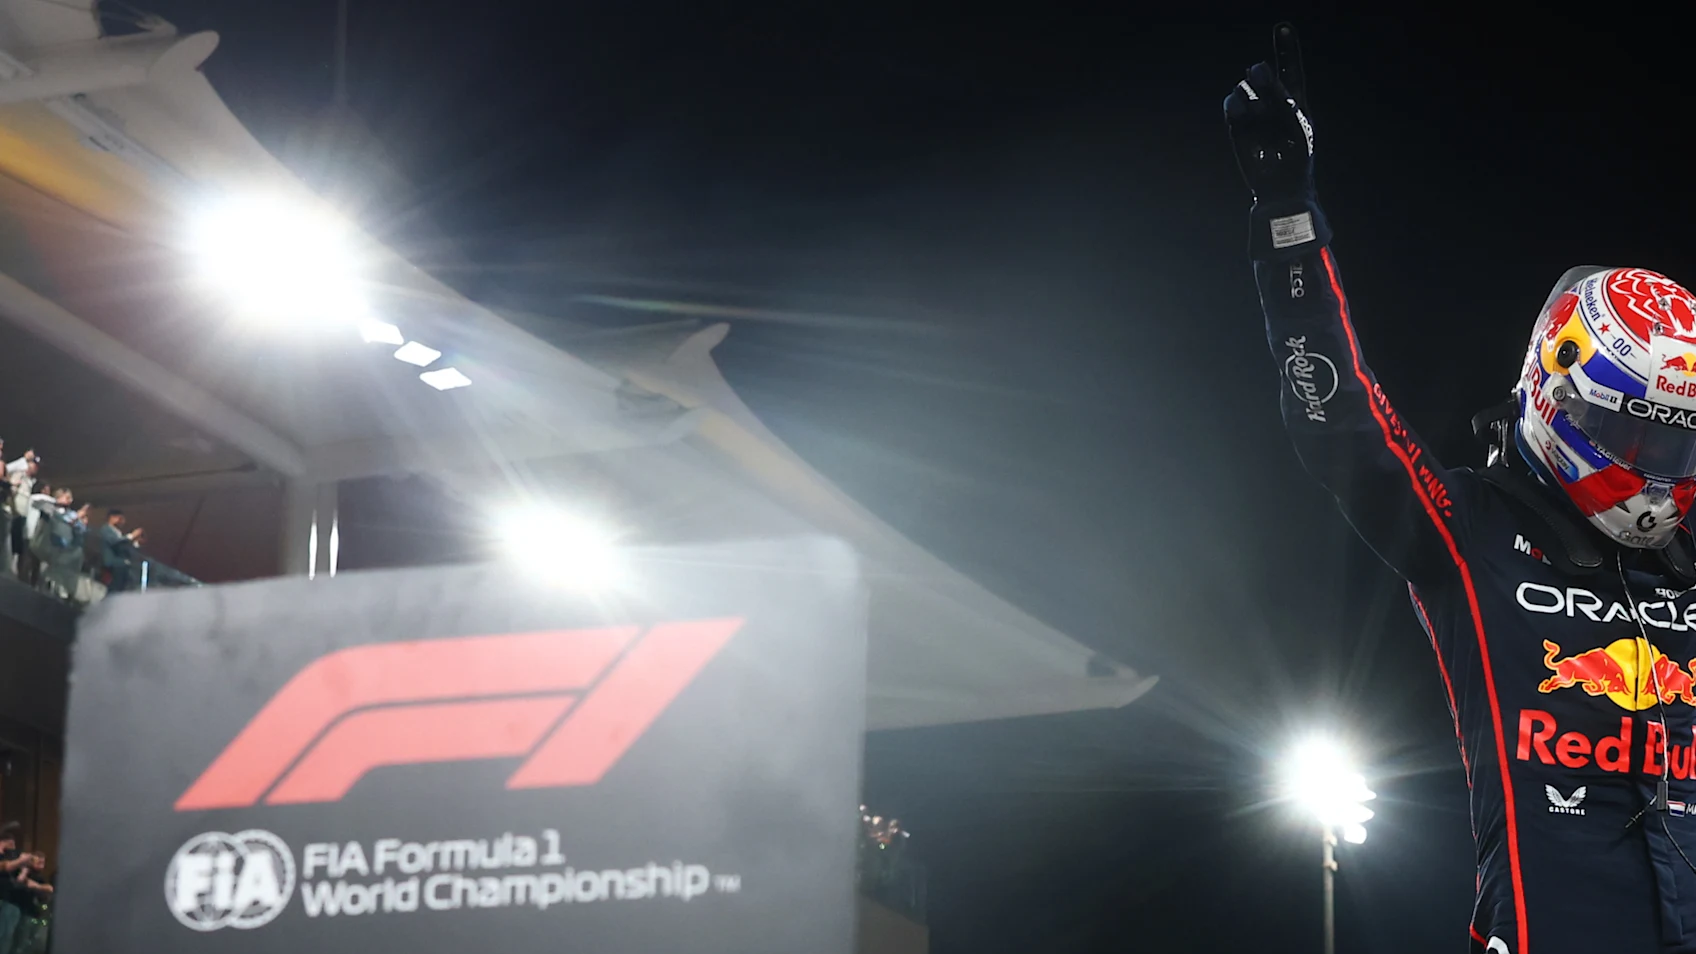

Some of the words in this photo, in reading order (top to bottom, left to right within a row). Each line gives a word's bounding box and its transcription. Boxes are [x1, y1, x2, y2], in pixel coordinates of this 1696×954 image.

[1585, 278, 1601, 321] Heineken
[1285, 335, 1314, 379] Rock
[1296, 380, 1327, 422] Hard
[1589, 389, 1609, 401] Mobil
[1656, 376, 1683, 393] Red
[174, 617, 747, 811] F1
[1516, 708, 1633, 773] Red
[1548, 806, 1586, 816] CASTORE
[303, 841, 370, 879] FIA
[373, 835, 538, 875] Formula
[539, 828, 566, 866] 1
[301, 877, 420, 917] World
[423, 859, 710, 910] Championship
